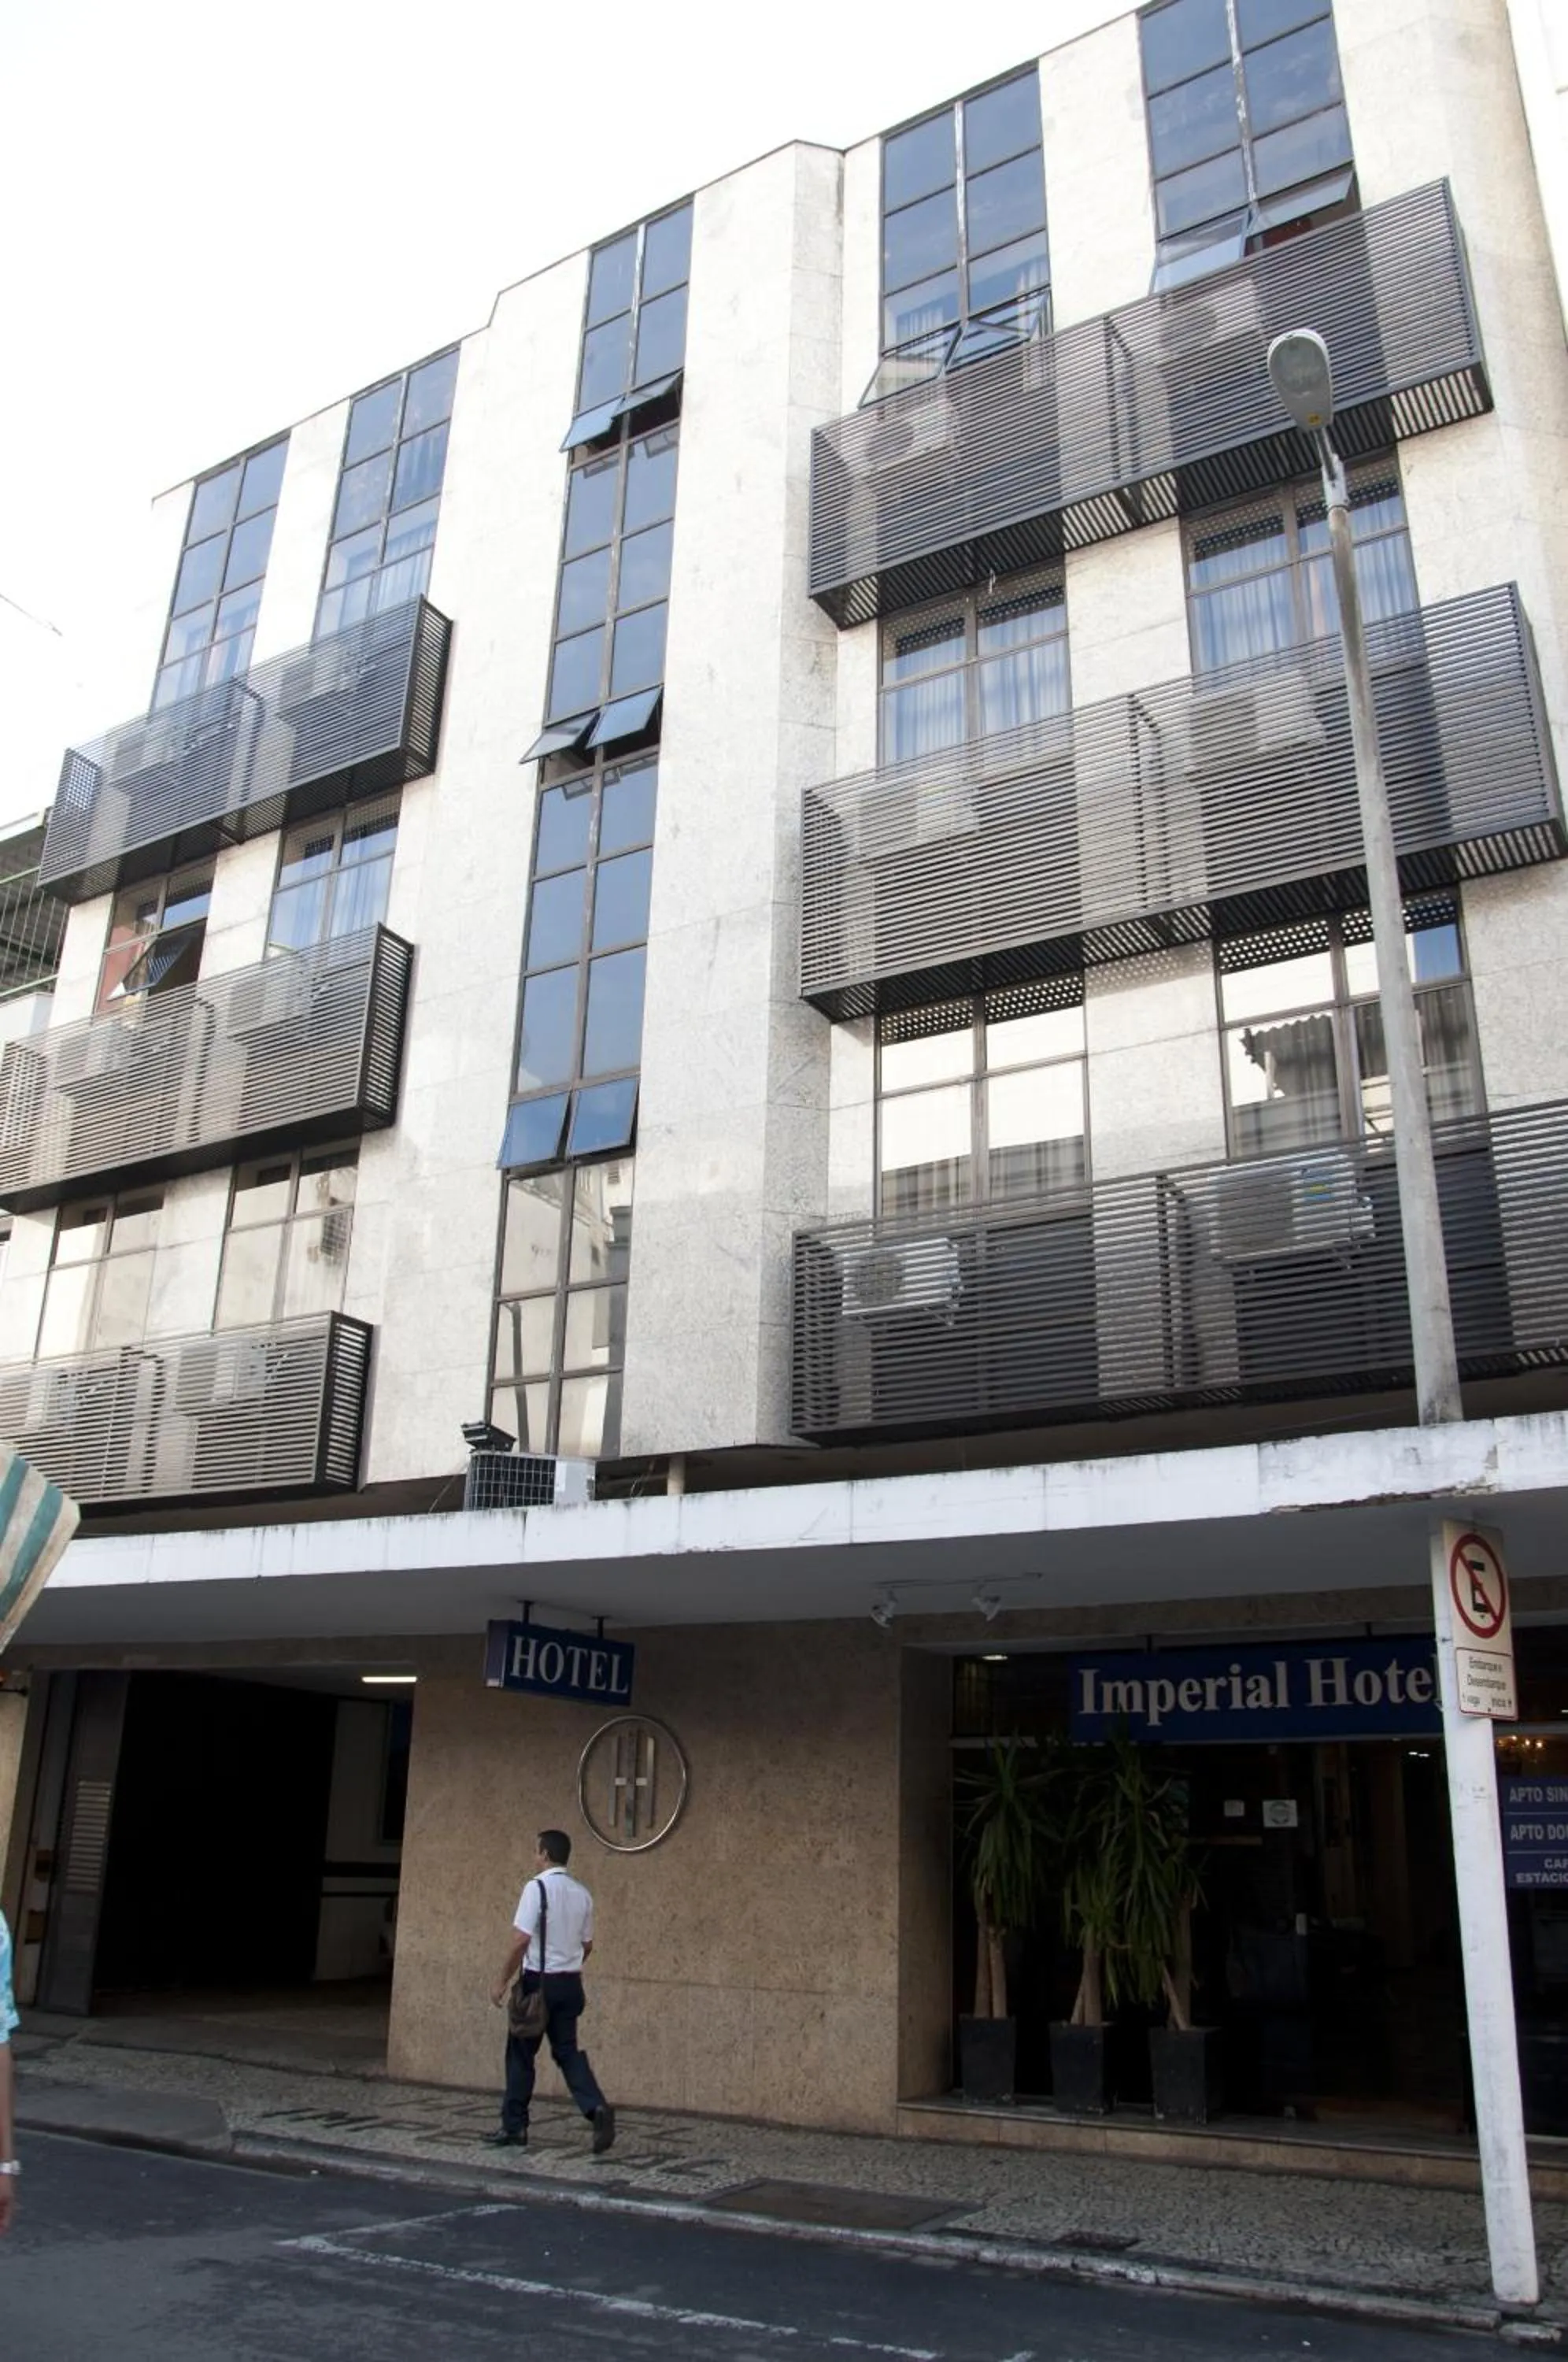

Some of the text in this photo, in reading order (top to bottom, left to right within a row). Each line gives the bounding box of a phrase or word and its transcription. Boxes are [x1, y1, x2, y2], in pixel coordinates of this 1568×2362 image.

[510, 1635, 628, 1694] HOTEL
[1078, 1661, 1291, 1727] Imperial
[1509, 1786, 1543, 1803] APTO
[1511, 1823, 1544, 1841] APTO
